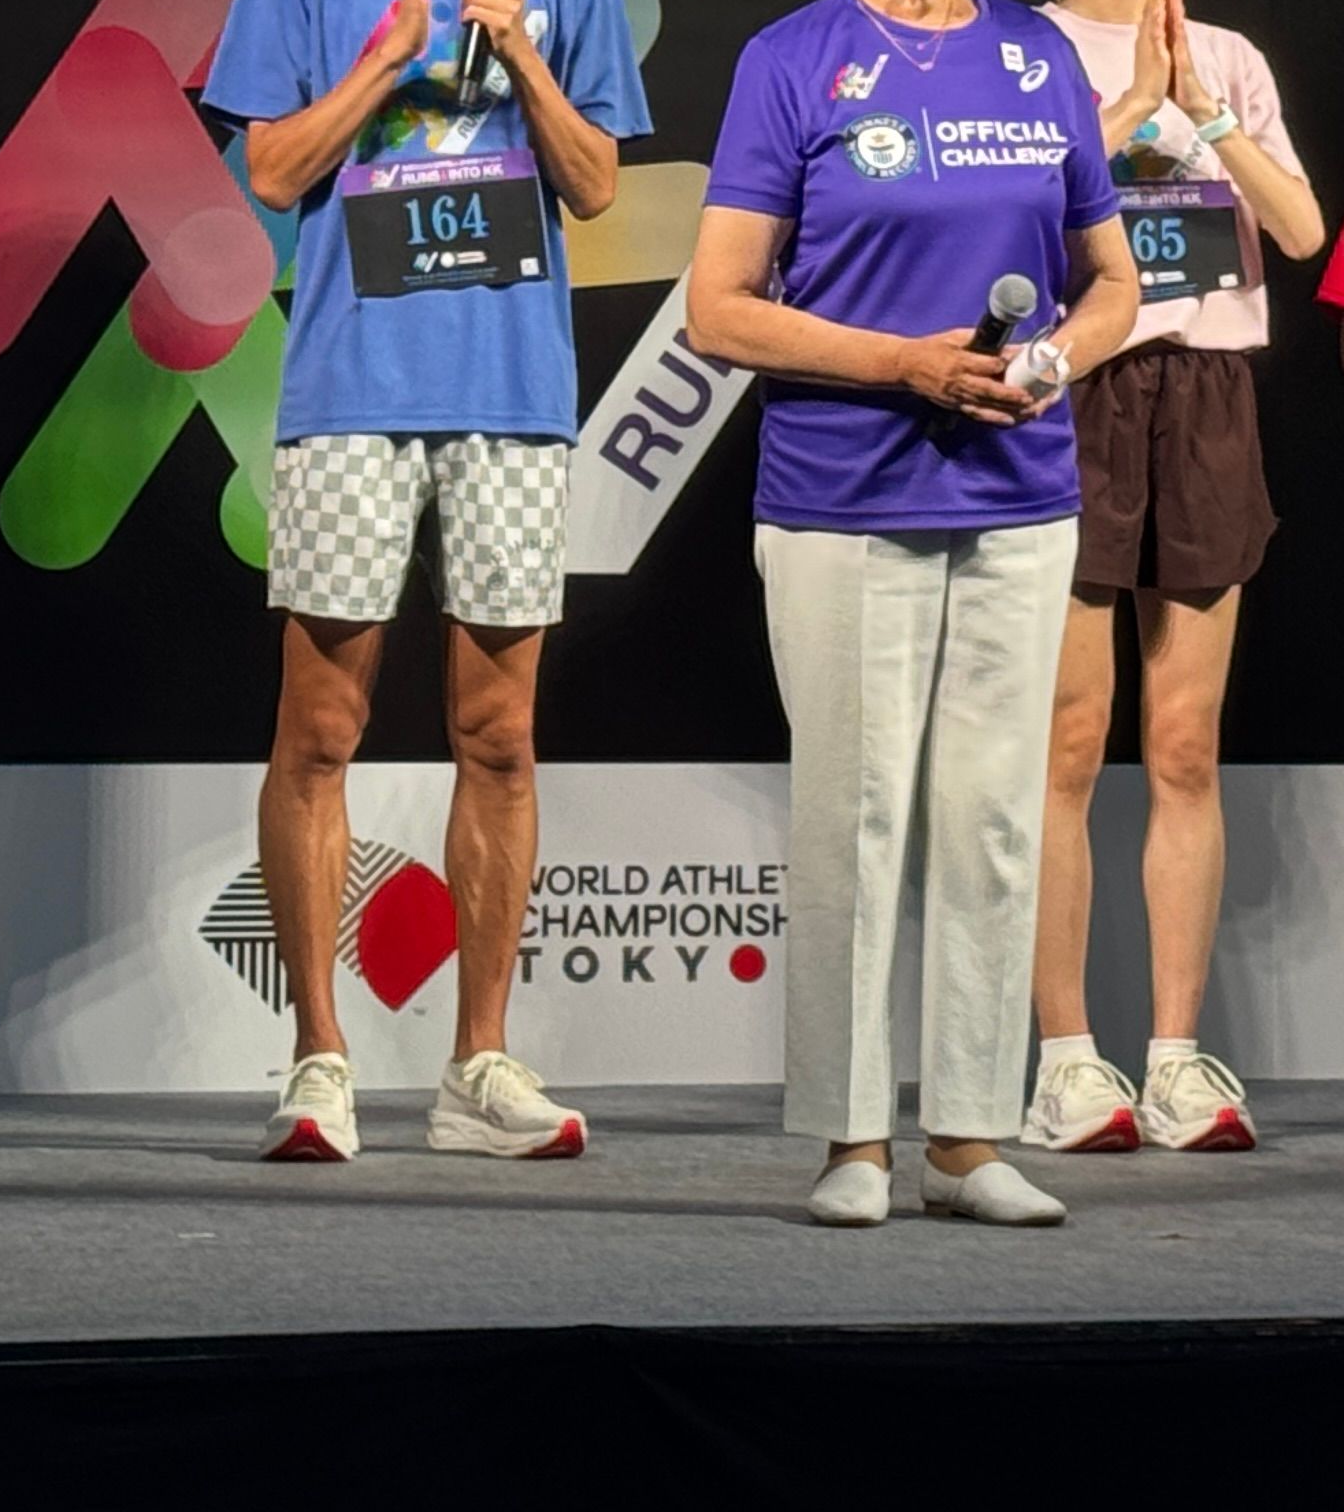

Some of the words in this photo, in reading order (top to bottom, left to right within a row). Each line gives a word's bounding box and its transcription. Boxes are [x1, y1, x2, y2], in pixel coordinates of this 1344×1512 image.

[936, 120, 1068, 144] OFFICIAL
[448, 166, 481, 181] INTO
[404, 191, 491, 246] 164
[659, 864, 789, 896] ATHLE
